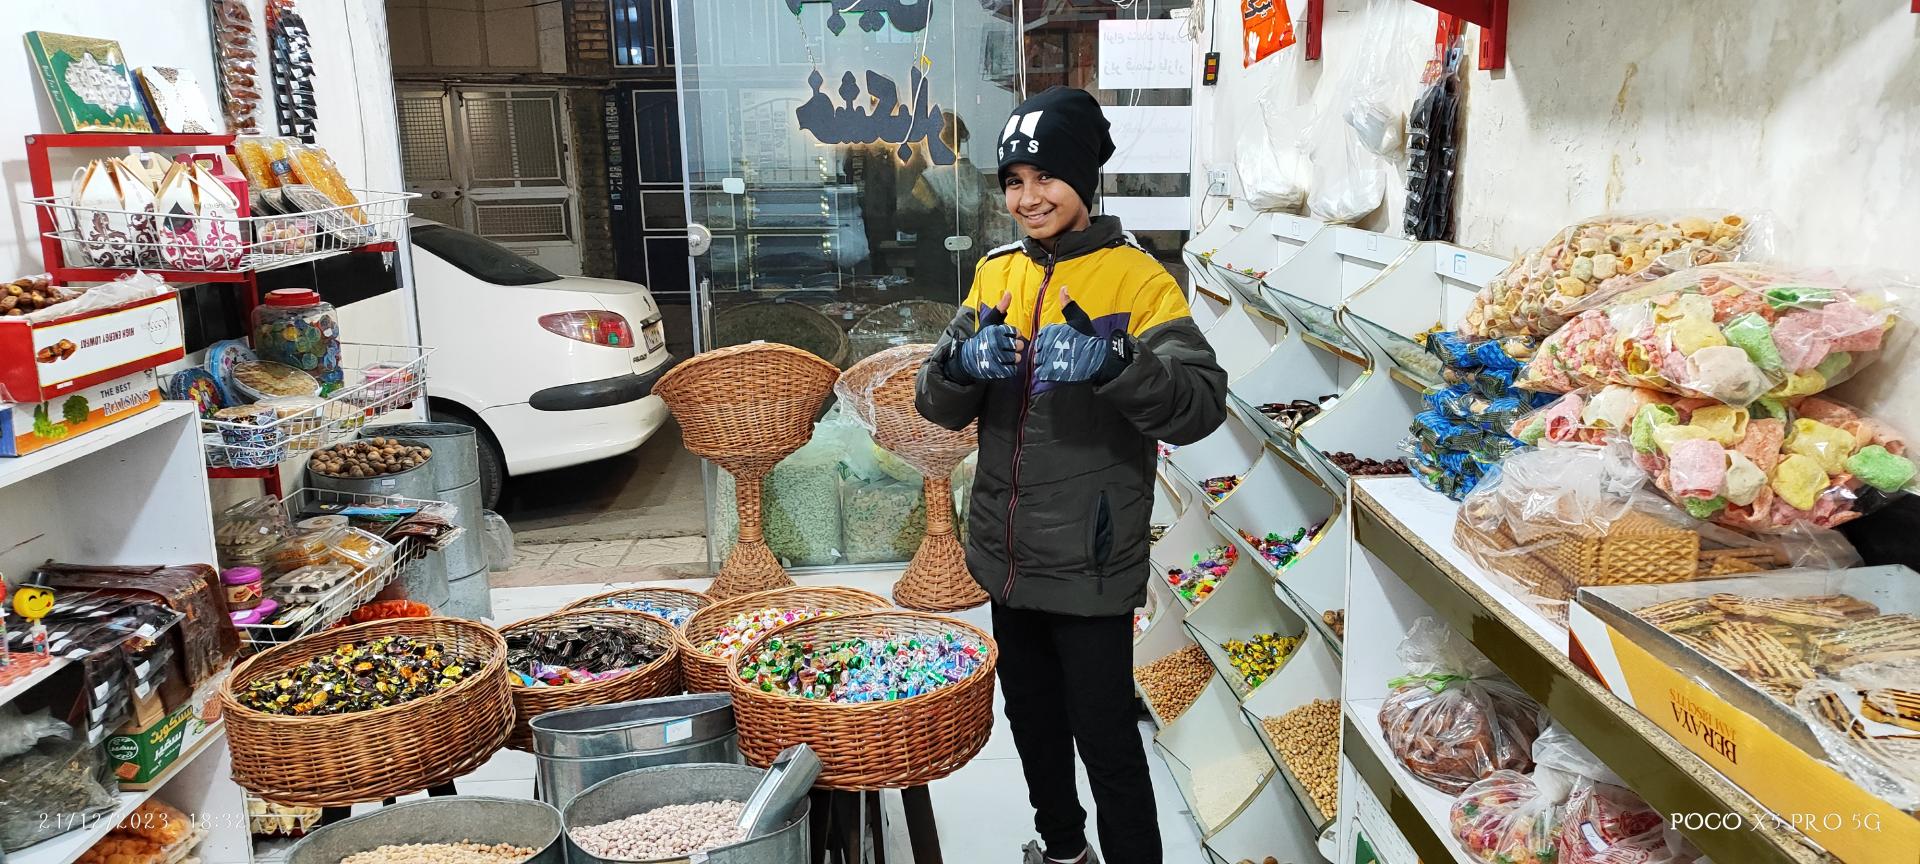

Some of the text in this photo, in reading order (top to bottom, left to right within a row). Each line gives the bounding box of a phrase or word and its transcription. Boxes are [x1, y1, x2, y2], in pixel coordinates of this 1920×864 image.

[998, 139, 1039, 161] BTS
[102, 330, 122, 343] ENERGY
[122, 327, 135, 339] HIGH
[100, 382, 131, 399] THE BEST
[1671, 702, 1738, 765] BERAYA
[1715, 718, 1737, 741] JAM
